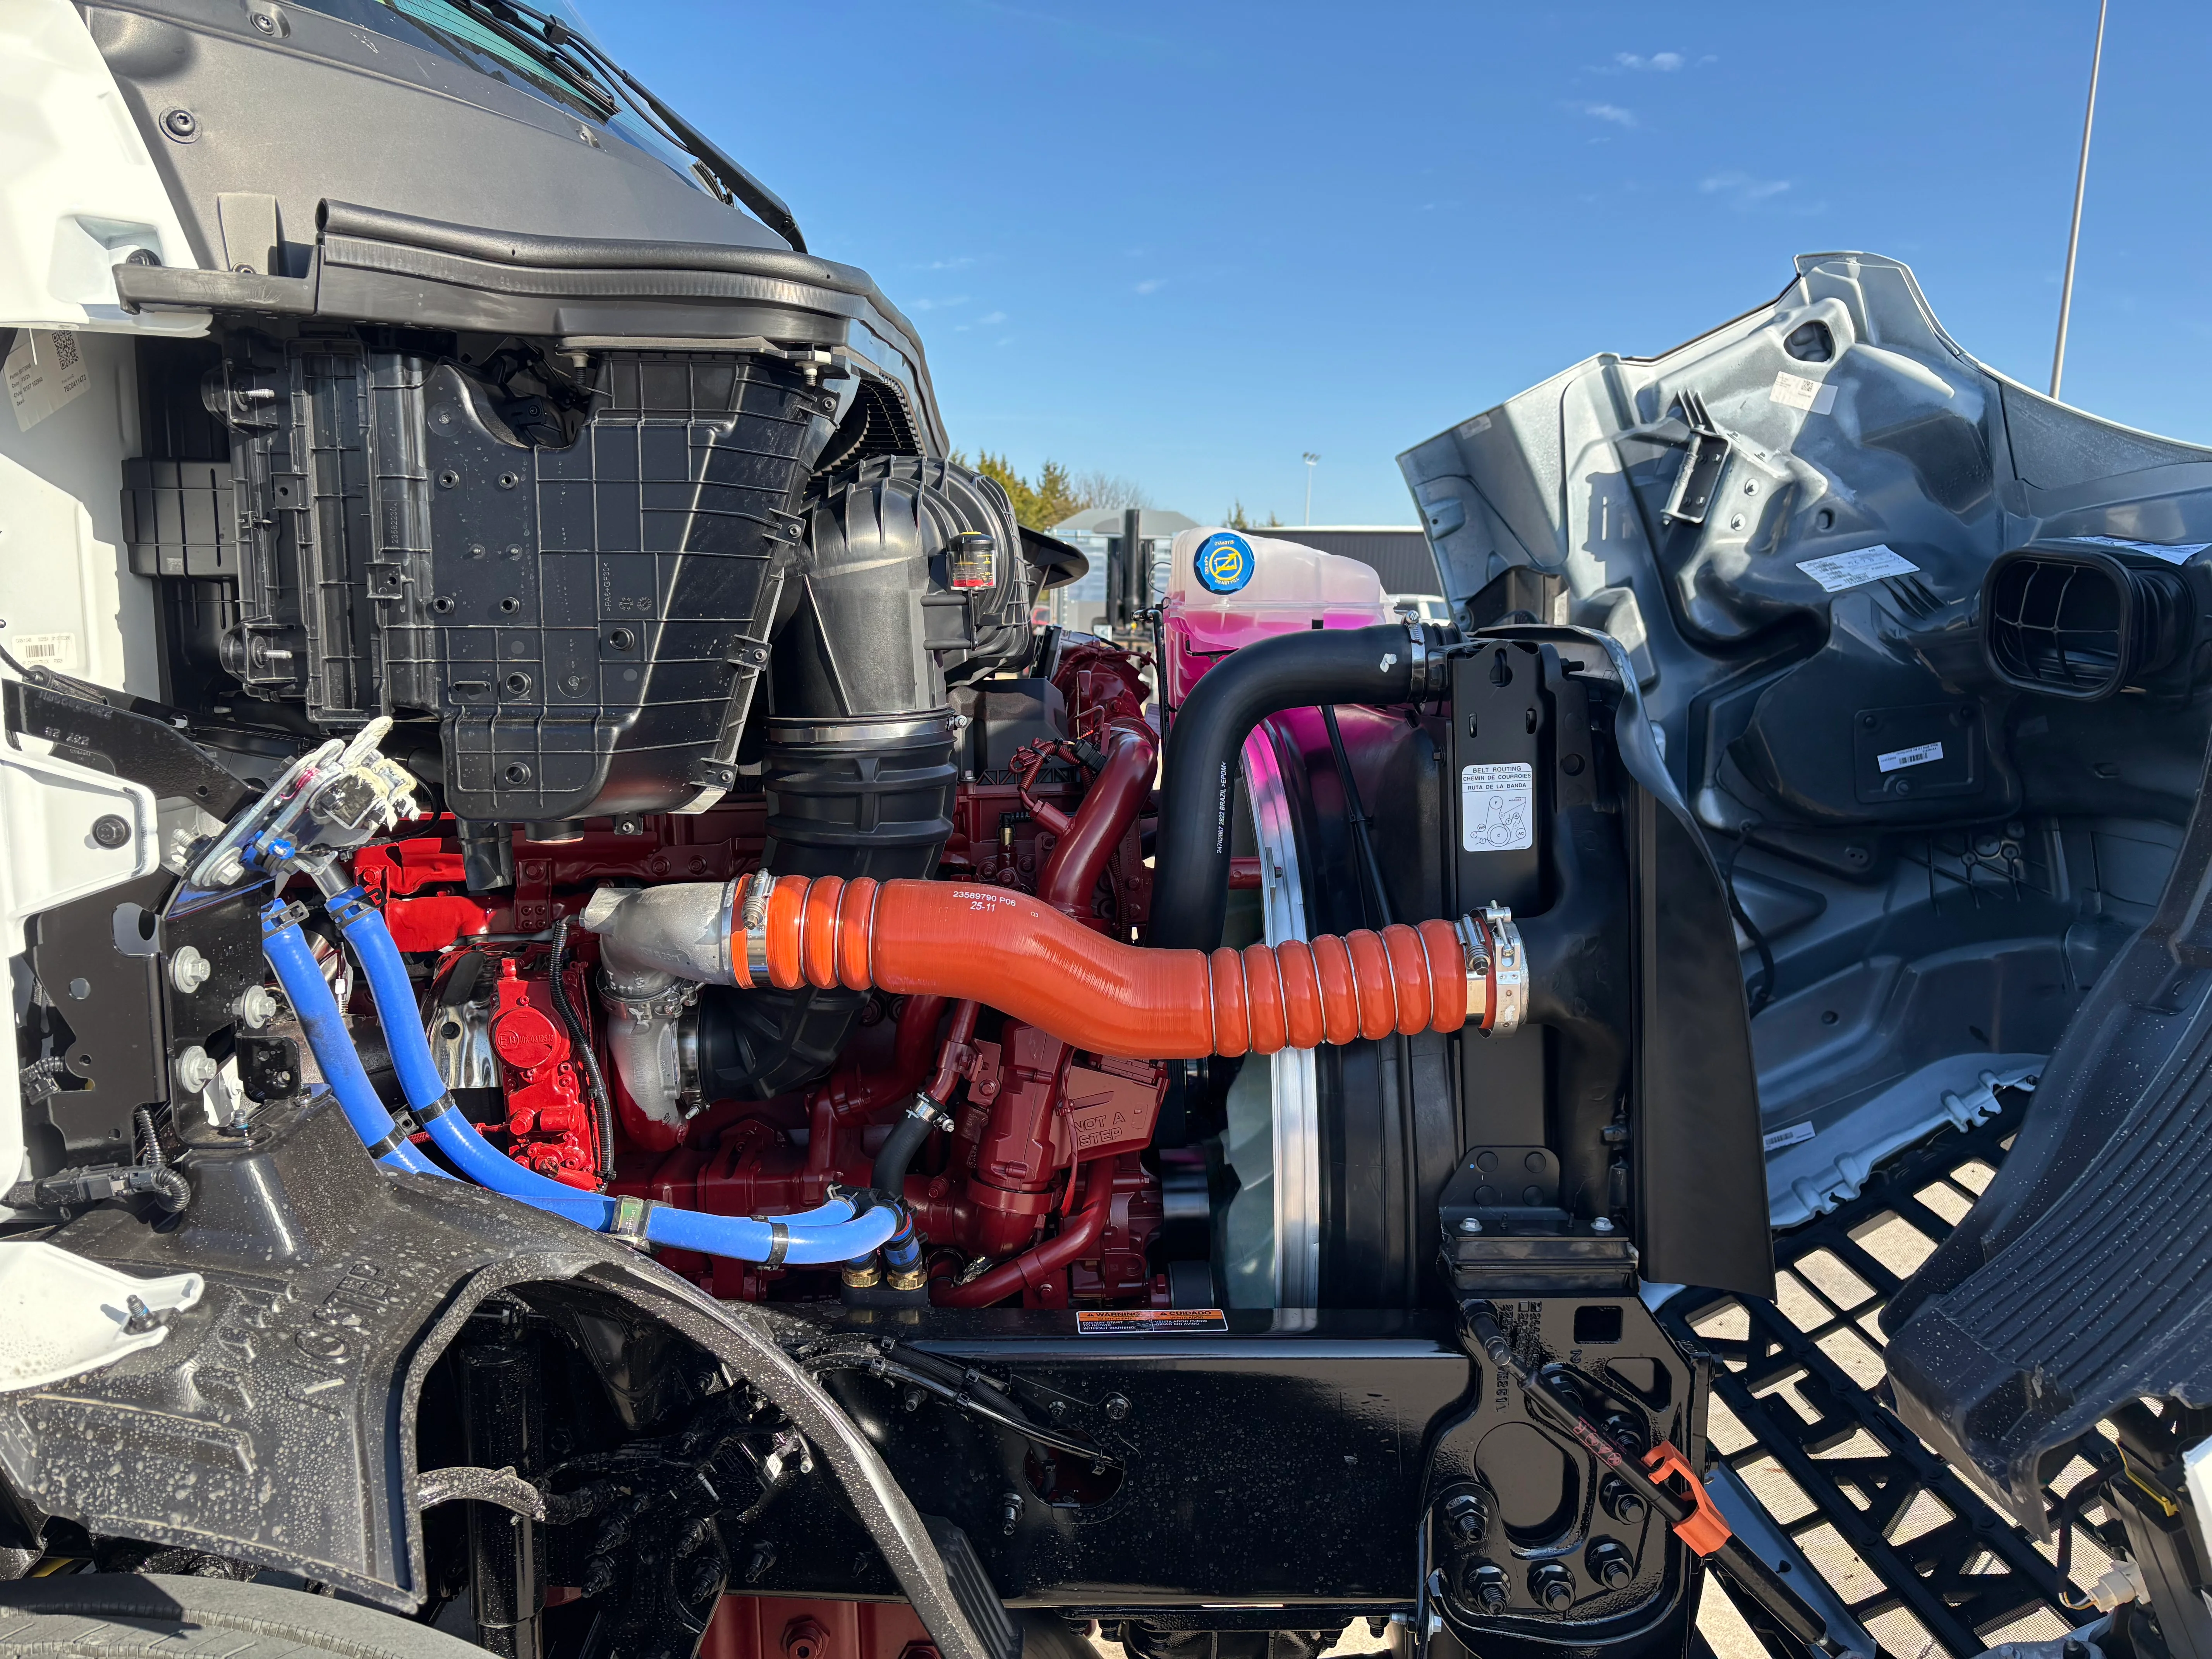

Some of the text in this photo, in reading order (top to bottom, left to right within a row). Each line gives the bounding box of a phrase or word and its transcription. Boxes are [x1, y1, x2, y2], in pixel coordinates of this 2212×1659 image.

[953, 891, 1016, 907] 23589790 P06
[970, 901, 995, 912] 25-11
[1074, 1112, 1126, 1132] NOT A
[1079, 1127, 1122, 1147] STEP
